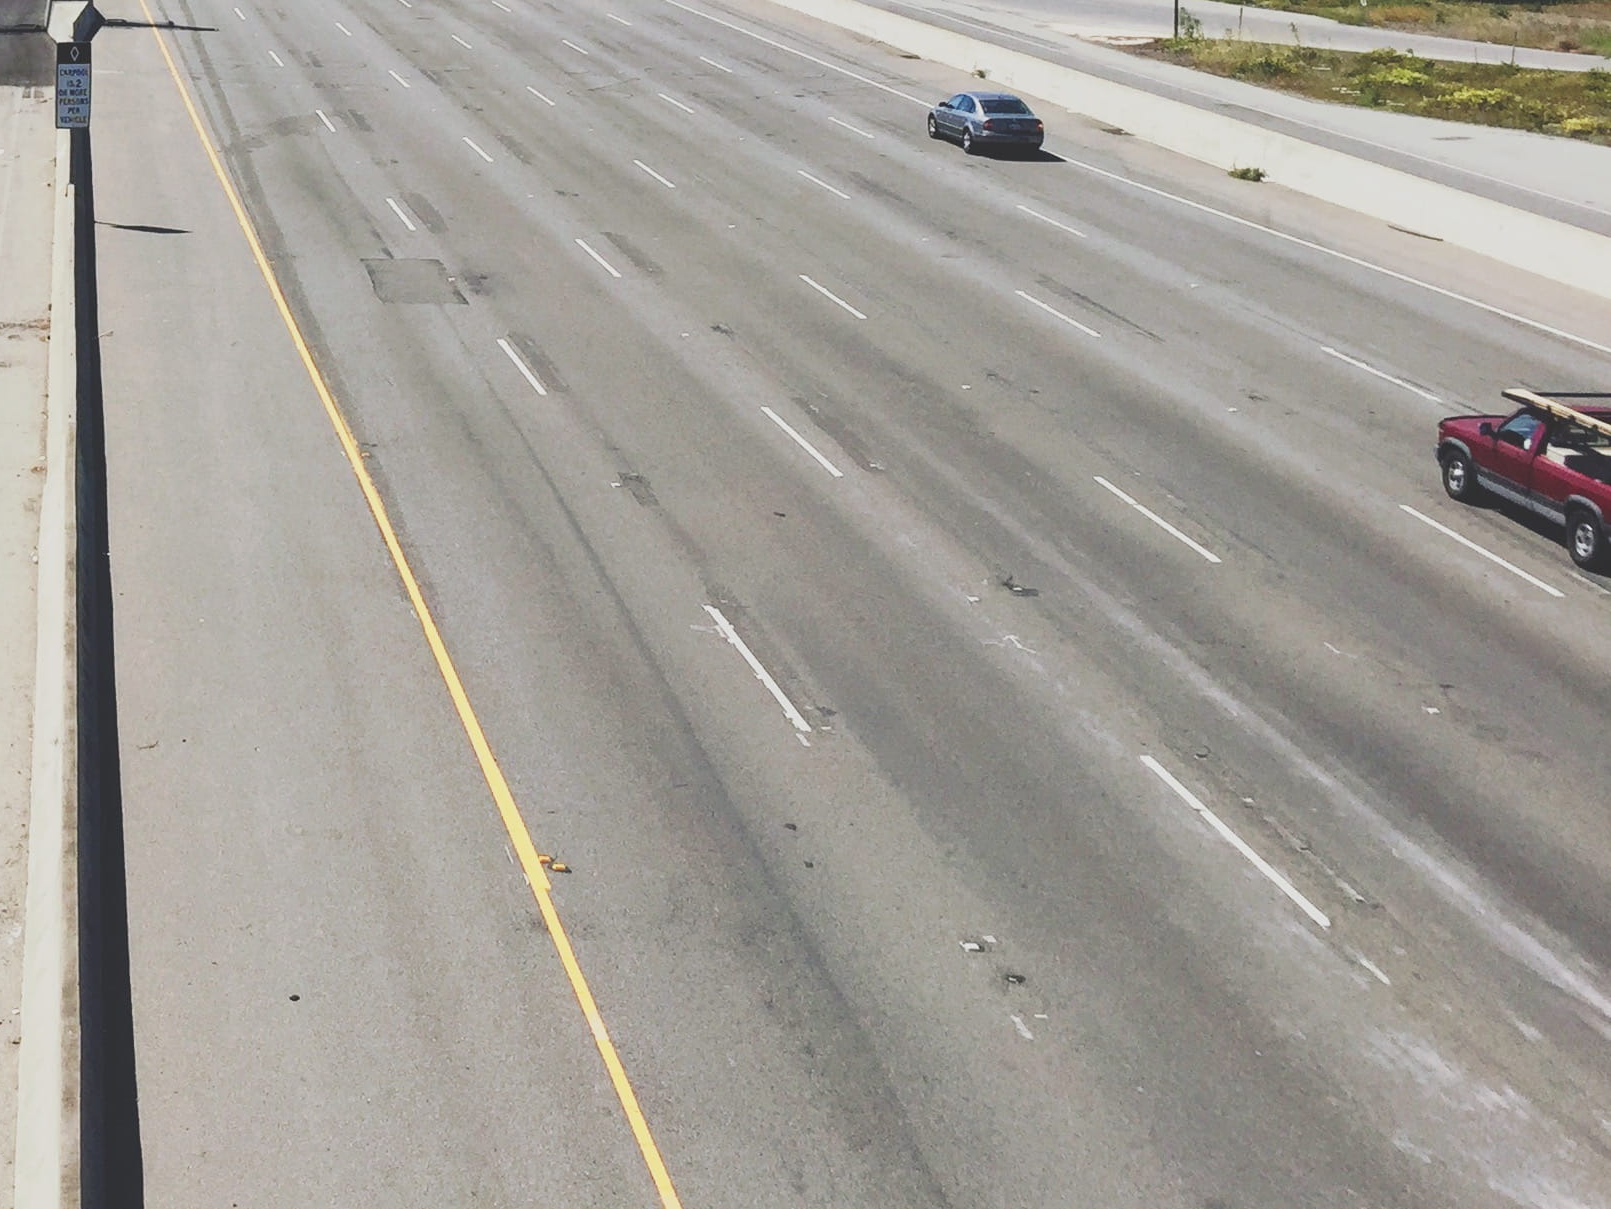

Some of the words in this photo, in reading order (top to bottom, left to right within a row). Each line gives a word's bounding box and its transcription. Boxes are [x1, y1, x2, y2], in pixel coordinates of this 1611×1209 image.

[75, 79, 83, 88] 2
[69, 88, 87, 96] MORE
[59, 97, 88, 105] PERSONS
